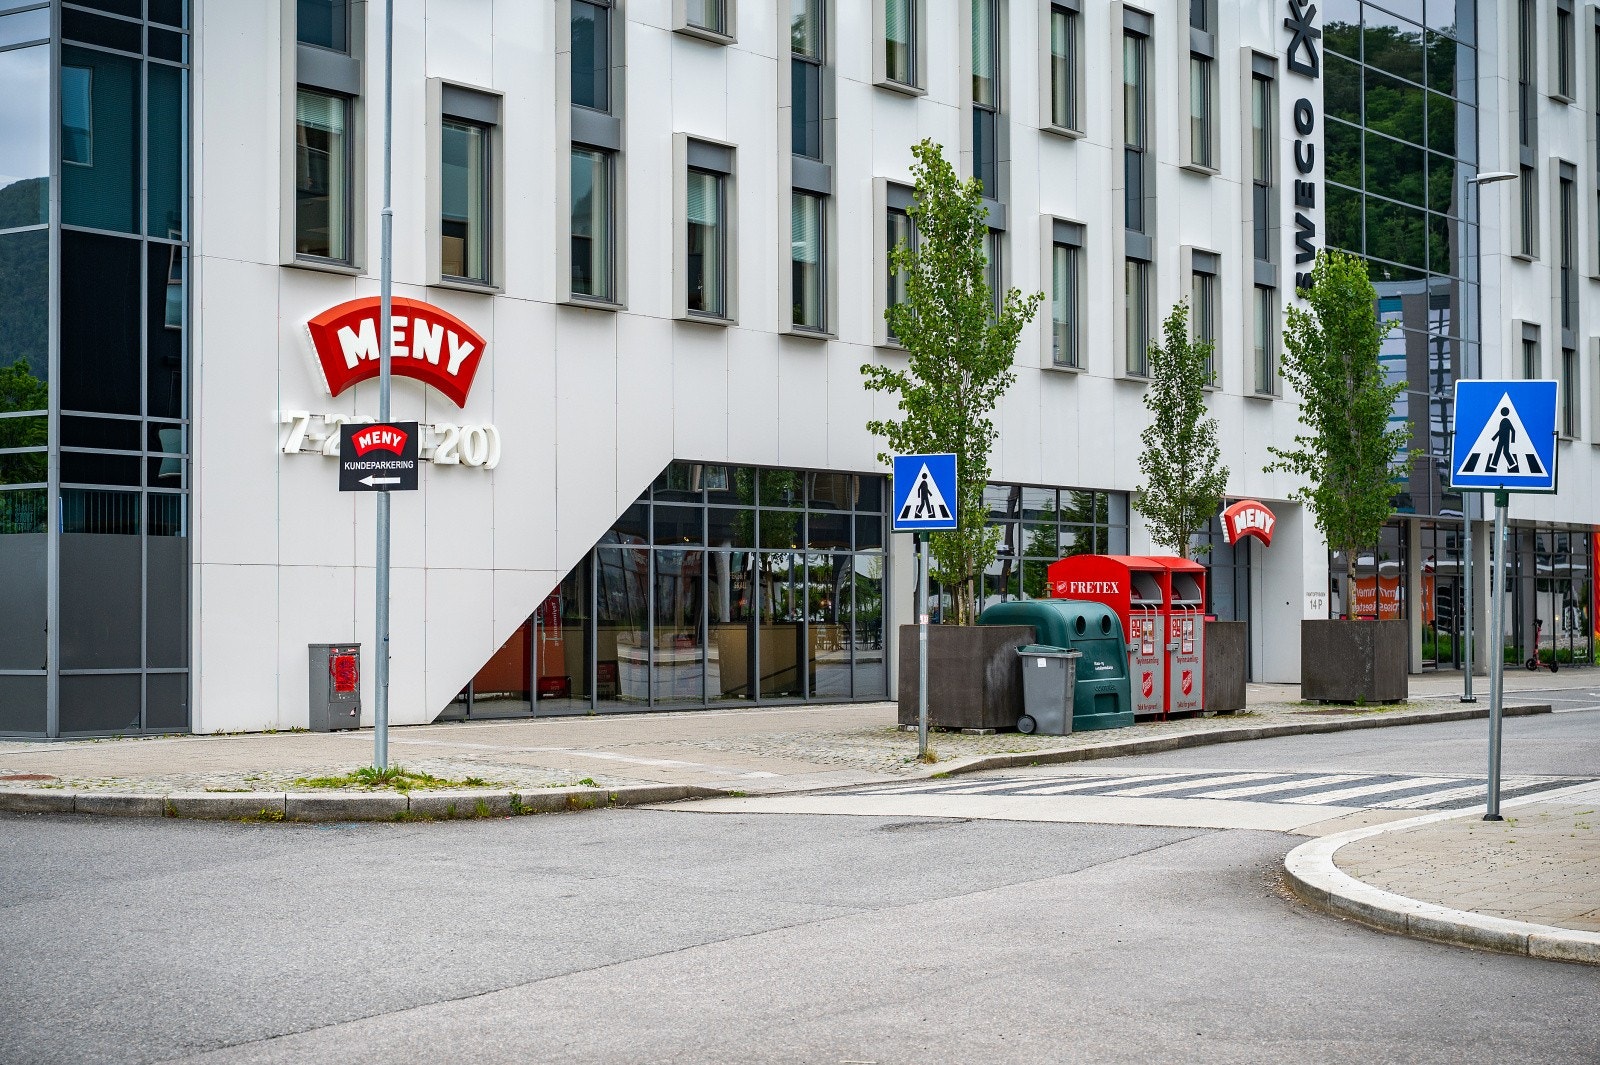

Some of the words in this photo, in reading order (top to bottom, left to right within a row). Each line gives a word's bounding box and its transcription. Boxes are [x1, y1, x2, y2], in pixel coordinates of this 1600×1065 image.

[337, 316, 475, 376] MENY
[358, 431, 402, 449] MENY
[344, 460, 414, 471] KUNDEPARKERING
[1234, 508, 1275, 534] MENY
[1070, 581, 1119, 594] FRETEX
[1310, 599, 1317, 610] 14
[1318, 599, 1323, 610] P
